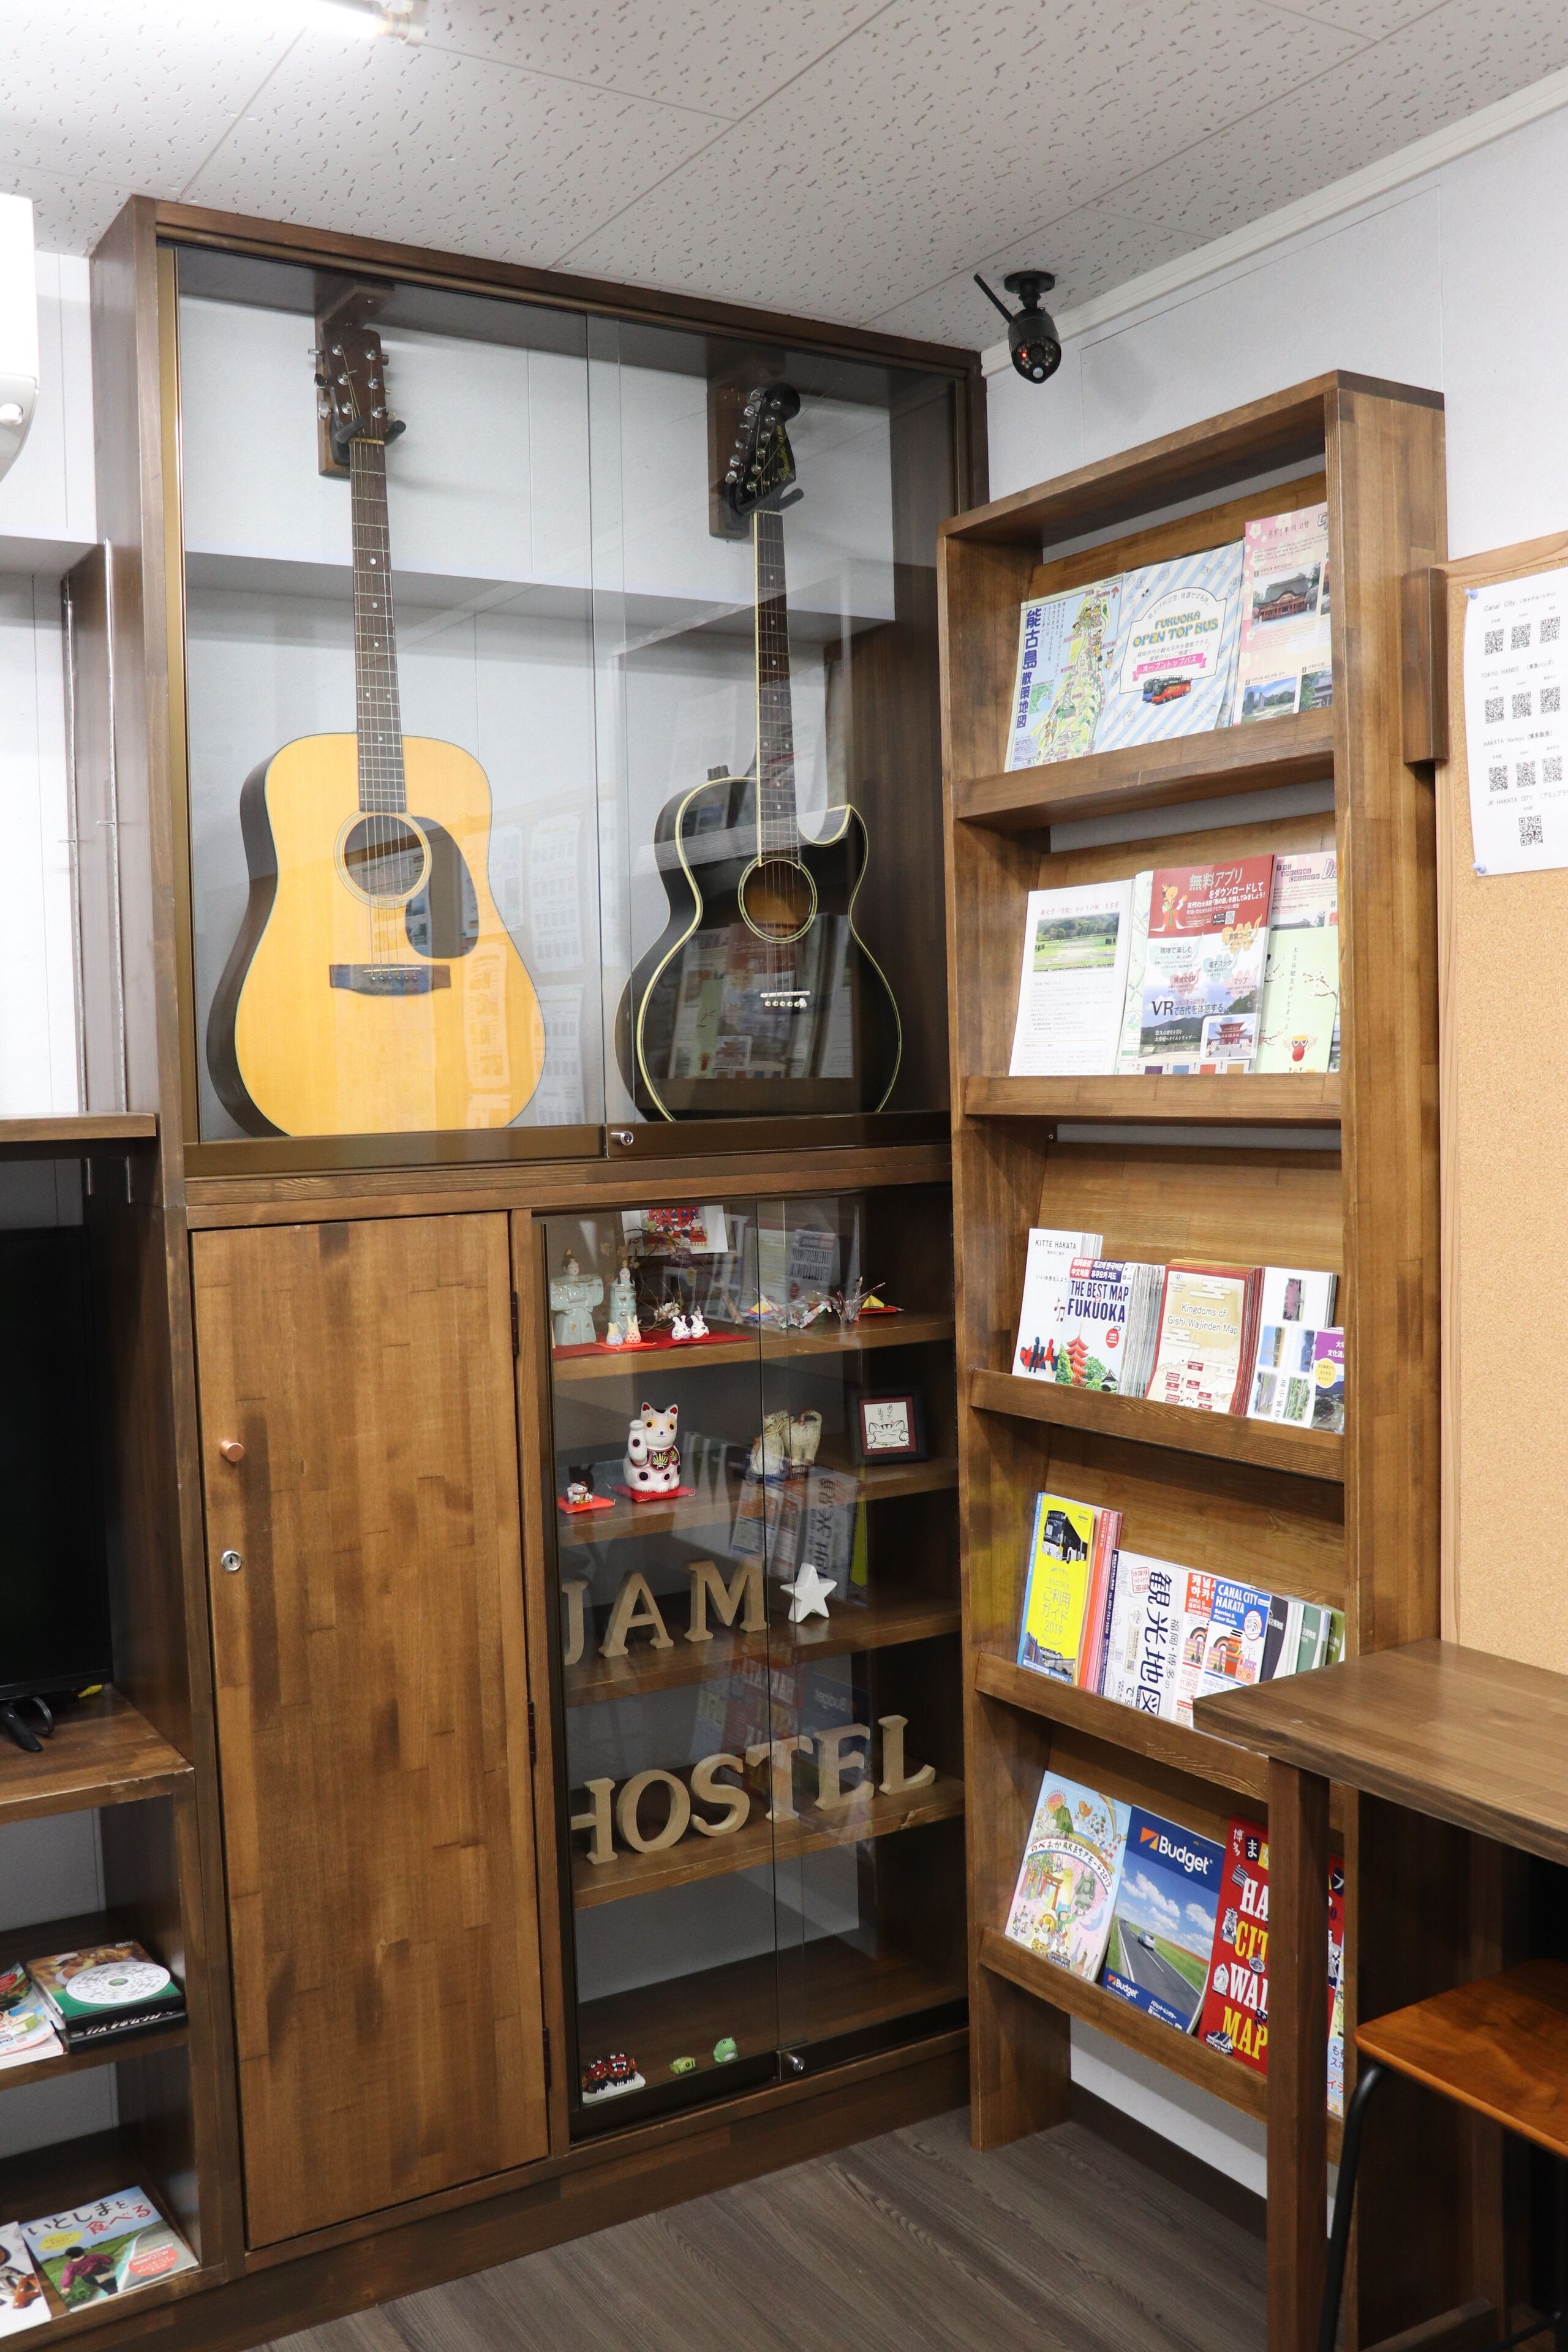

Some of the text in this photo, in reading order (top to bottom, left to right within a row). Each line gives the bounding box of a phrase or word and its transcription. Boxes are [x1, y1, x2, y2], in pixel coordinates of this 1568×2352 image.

[1484, 603, 1499, 611] Canal
[1155, 611, 1200, 630] FUKUOKA
[1133, 617, 1219, 647] OPEN TOP BUS
[1017, 608, 1042, 729] 能古島散策地図
[1189, 867, 1243, 891] 無料アプリ
[1209, 882, 1264, 899] をダウンロードして
[1152, 1000, 1174, 1016] VR
[1035, 1239, 1076, 1250] KITTE HAKATA
[1071, 1280, 1129, 1302] THE BEST MAP
[1067, 1298, 1125, 1323] FUKUOKA
[1182, 1303, 1216, 1316] Kingdoms
[1167, 1316, 1238, 1335] Gishi Wajinden Map
[1043, 1586, 1071, 1610] ご利用
[1216, 1596, 1245, 1614] HAKATA
[1218, 1585, 1258, 1606] CANAL CITY
[562, 1559, 770, 1665] JAM
[1041, 1602, 1068, 1623] ガイド
[1215, 1608, 1231, 1618] Service
[1044, 1620, 1063, 1636] 2019
[1138, 1570, 1172, 1715] 観光地図
[570, 1715, 935, 1865] HOSTEL
[1232, 1828, 1244, 1856] 博多
[1159, 1835, 1208, 1875] Budget
[1116, 1979, 1137, 1999] Budget
[1222, 2006, 1268, 2059] MAP
[28, 2200, 129, 2236] いとしまを
[85, 2205, 151, 2234] 食べる
